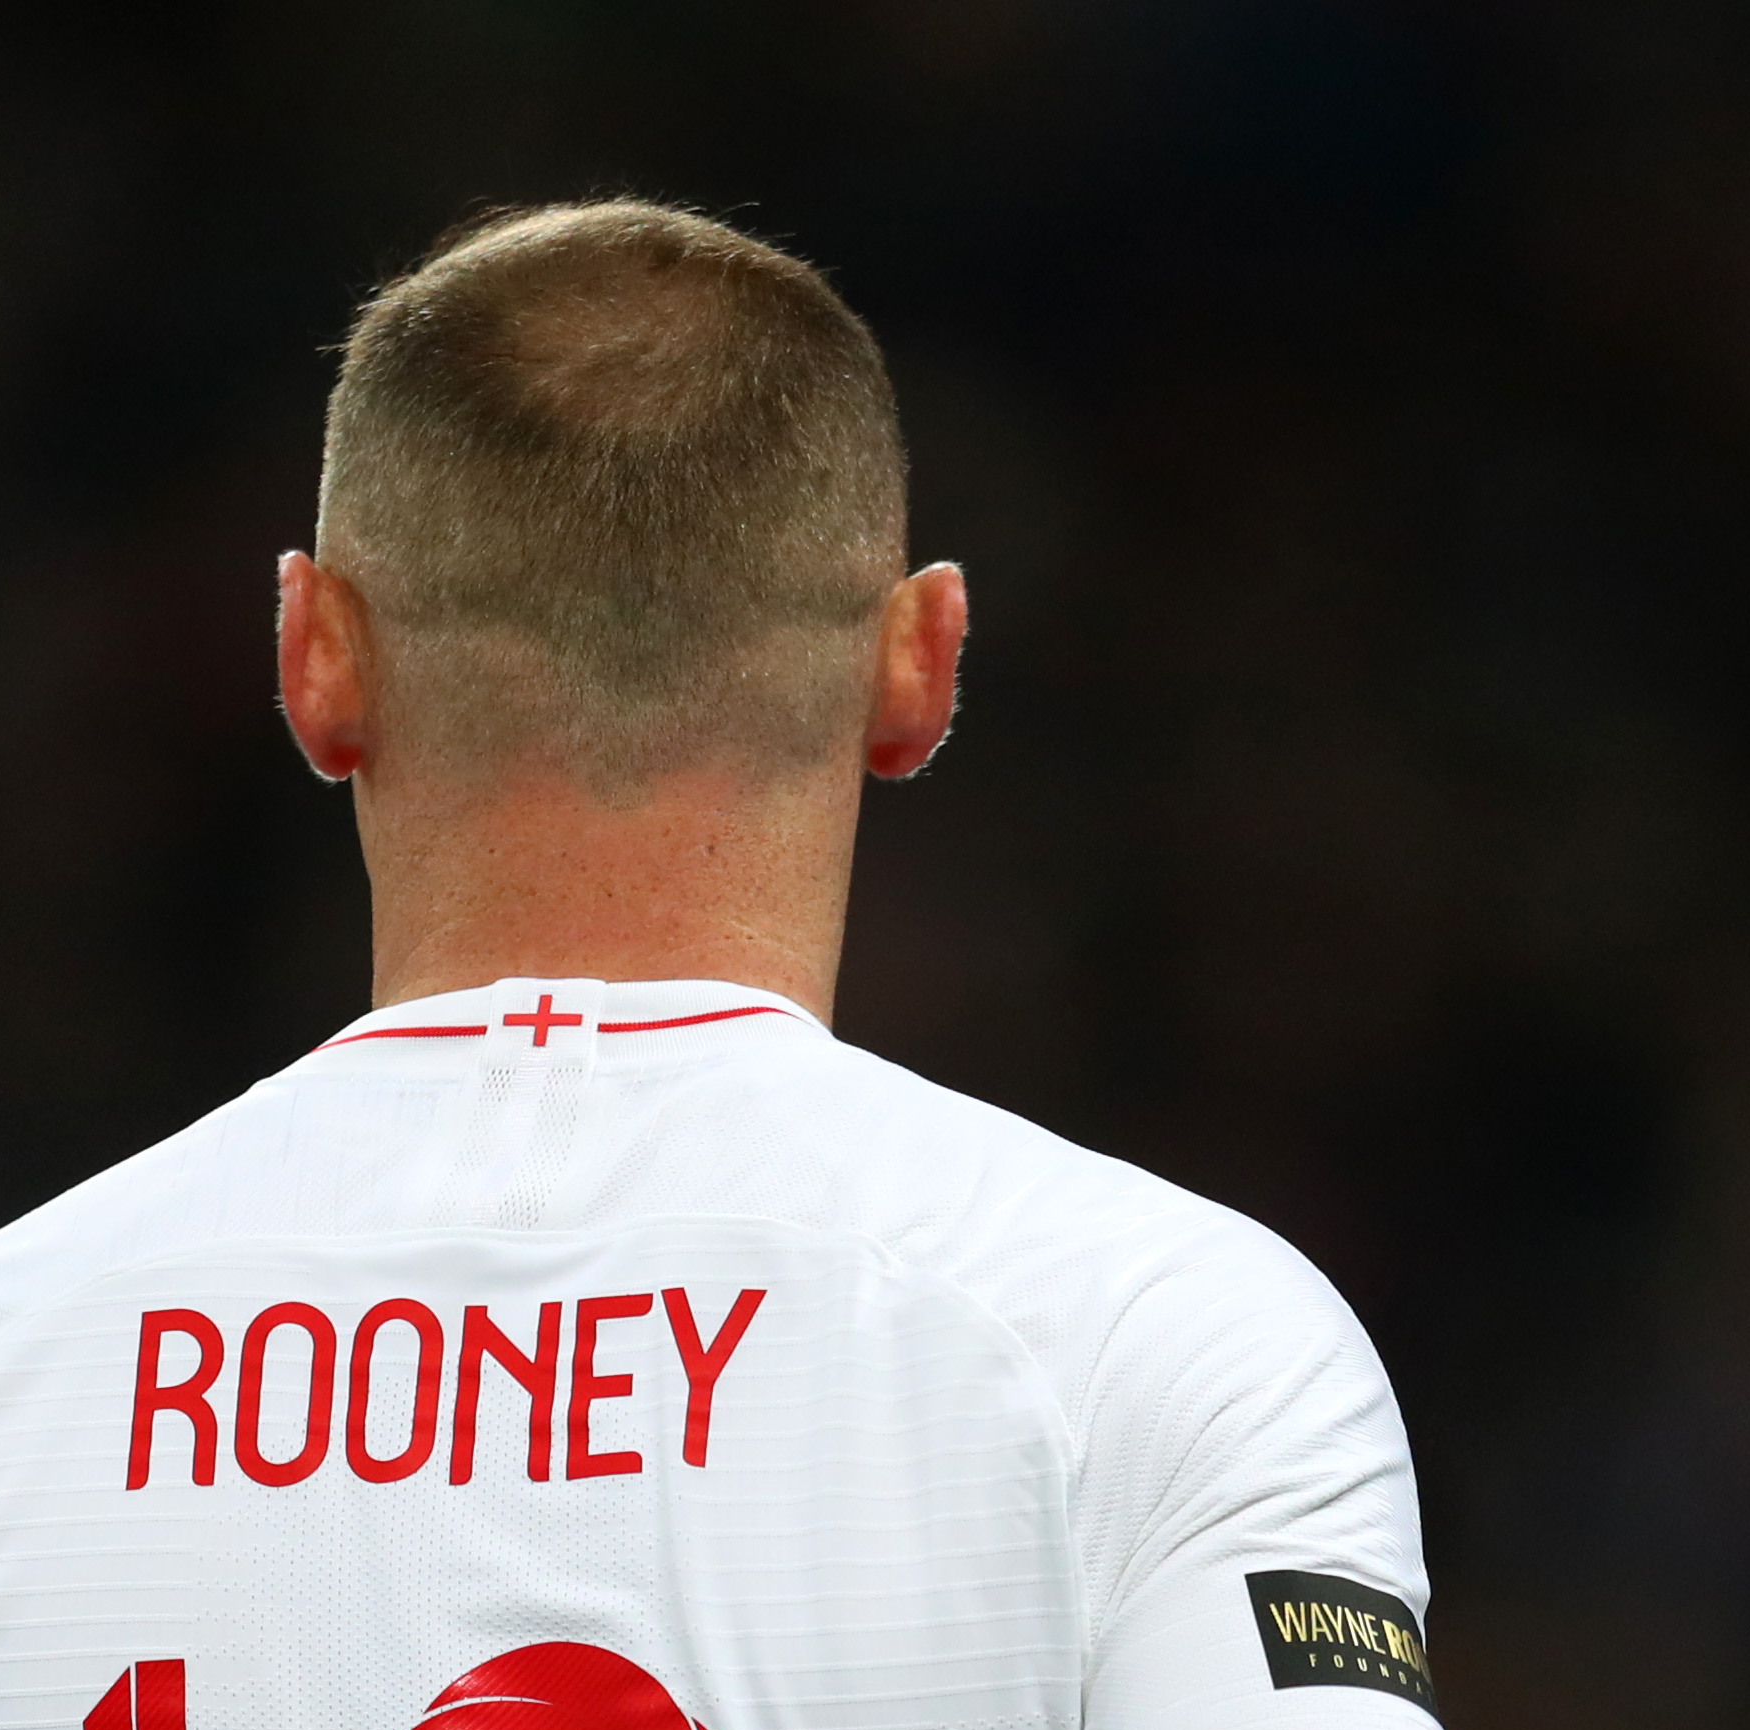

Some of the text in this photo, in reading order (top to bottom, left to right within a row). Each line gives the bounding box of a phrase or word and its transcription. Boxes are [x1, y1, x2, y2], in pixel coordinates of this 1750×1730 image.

[125, 1287, 767, 1491] ROONEY
[1269, 1601, 1386, 1655] WAYNE
[1309, 1653, 1429, 1698] FOUNDA
